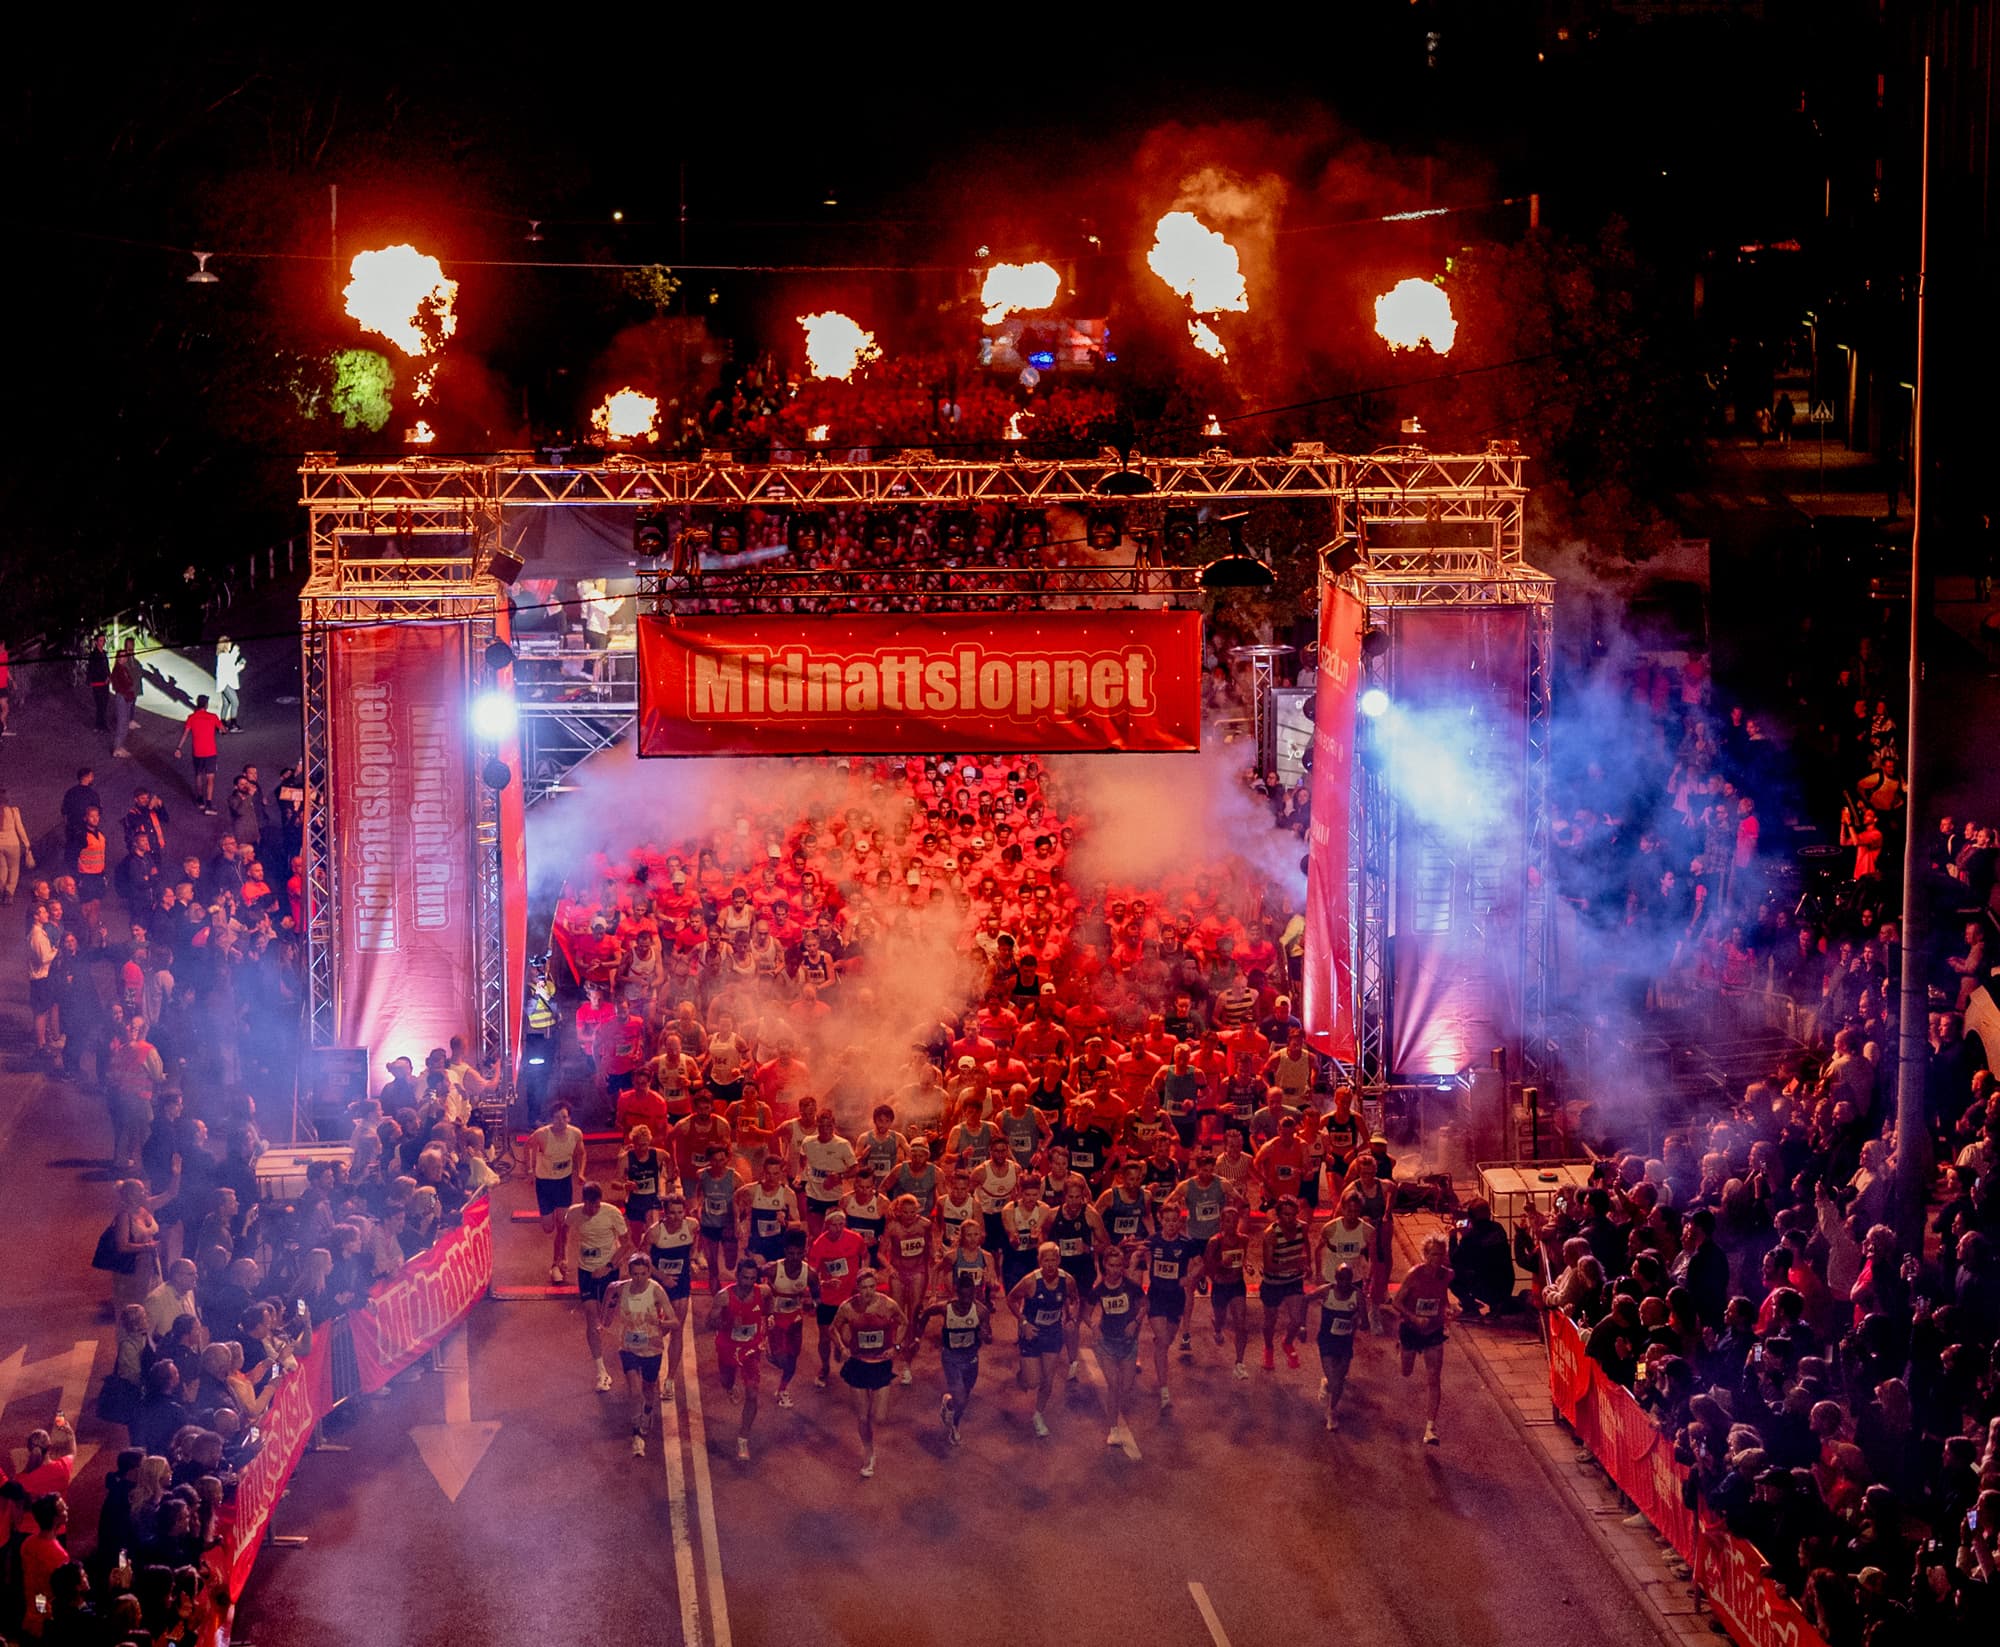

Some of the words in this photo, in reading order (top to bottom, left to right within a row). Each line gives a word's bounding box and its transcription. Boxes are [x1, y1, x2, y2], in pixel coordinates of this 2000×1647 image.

[692, 649, 1149, 717] Midnattsloppet
[410, 705, 449, 858] Midnight
[354, 686, 394, 949] Midnattsloppet
[416, 862, 449, 927] Run
[1202, 1207, 1214, 1216] 67
[905, 1240, 922, 1251] 150
[866, 1334, 877, 1343] 10
